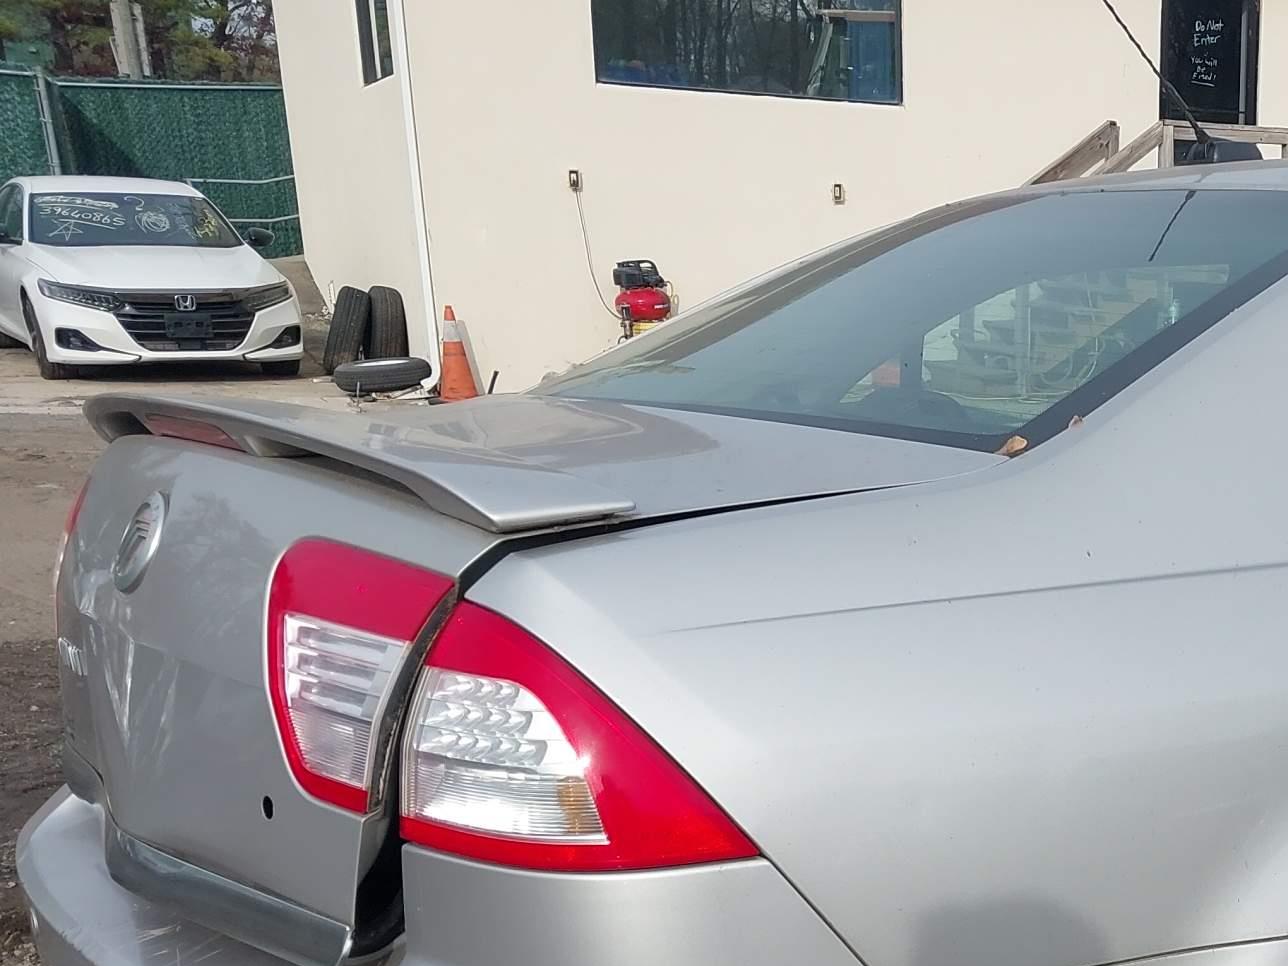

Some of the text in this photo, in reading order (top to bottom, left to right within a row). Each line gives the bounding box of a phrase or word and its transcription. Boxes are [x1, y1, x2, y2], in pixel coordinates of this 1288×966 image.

[1195, 19, 1224, 32] Do Not
[1193, 33, 1221, 47] Enter
